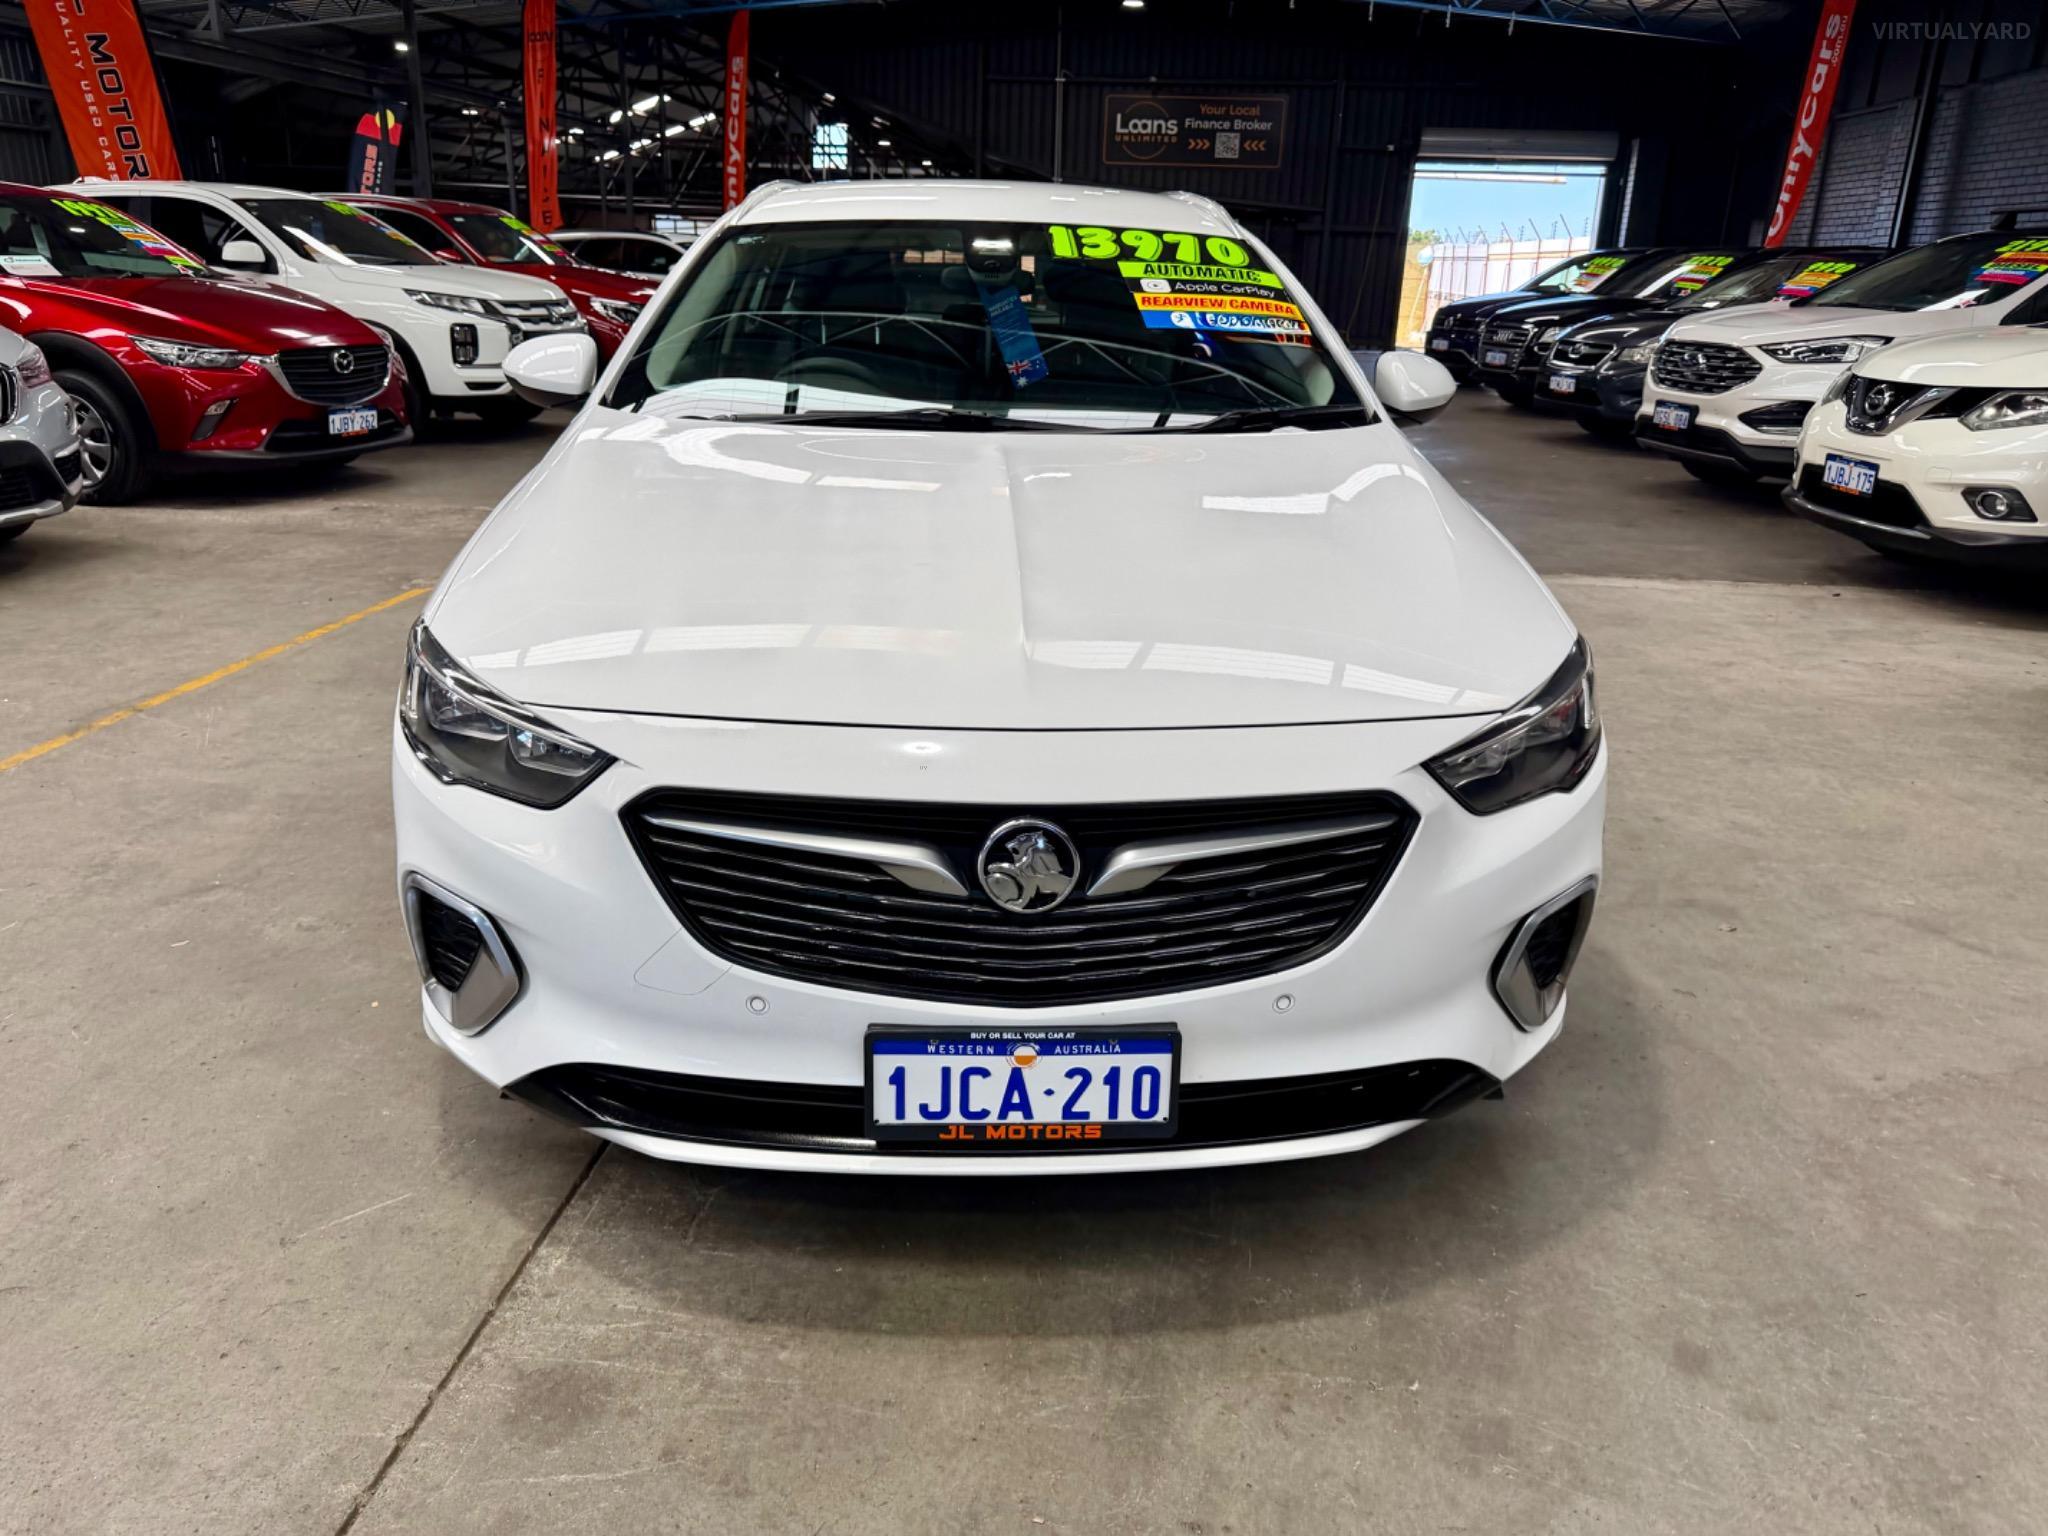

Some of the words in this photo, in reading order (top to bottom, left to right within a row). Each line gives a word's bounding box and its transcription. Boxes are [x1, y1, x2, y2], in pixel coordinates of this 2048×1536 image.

[80, 80, 103, 127] USED
[1200, 104, 1226, 115] Your
[1229, 104, 1261, 116] Local
[1115, 113, 1178, 135] Loans
[1184, 117, 1230, 130] Finance
[1234, 119, 1272, 131] Broker
[1115, 134, 1178, 143] UNLIMITED
[1049, 225, 1250, 267] 13970
[1143, 263, 1262, 283] AUTOMATIC
[1175, 281, 1218, 293] Apple
[1221, 283, 1276, 299] CarPlay
[1141, 295, 1223, 308] REARVIEW
[1229, 298, 1296, 315] CAMERA
[971, 1032, 986, 1040] BUY
[989, 1032, 1000, 1040] OR
[1002, 1032, 1021, 1040] SELL
[1024, 1032, 1046, 1040] YOUR
[1048, 1032, 1064, 1040] CAR
[1065, 1032, 1076, 1040] AT
[927, 1044, 995, 1055] WESTERN
[1054, 1044, 1122, 1054] AUSTRALIA
[939, 1125, 975, 1139] JL
[986, 1124, 1103, 1139] MOTORS
